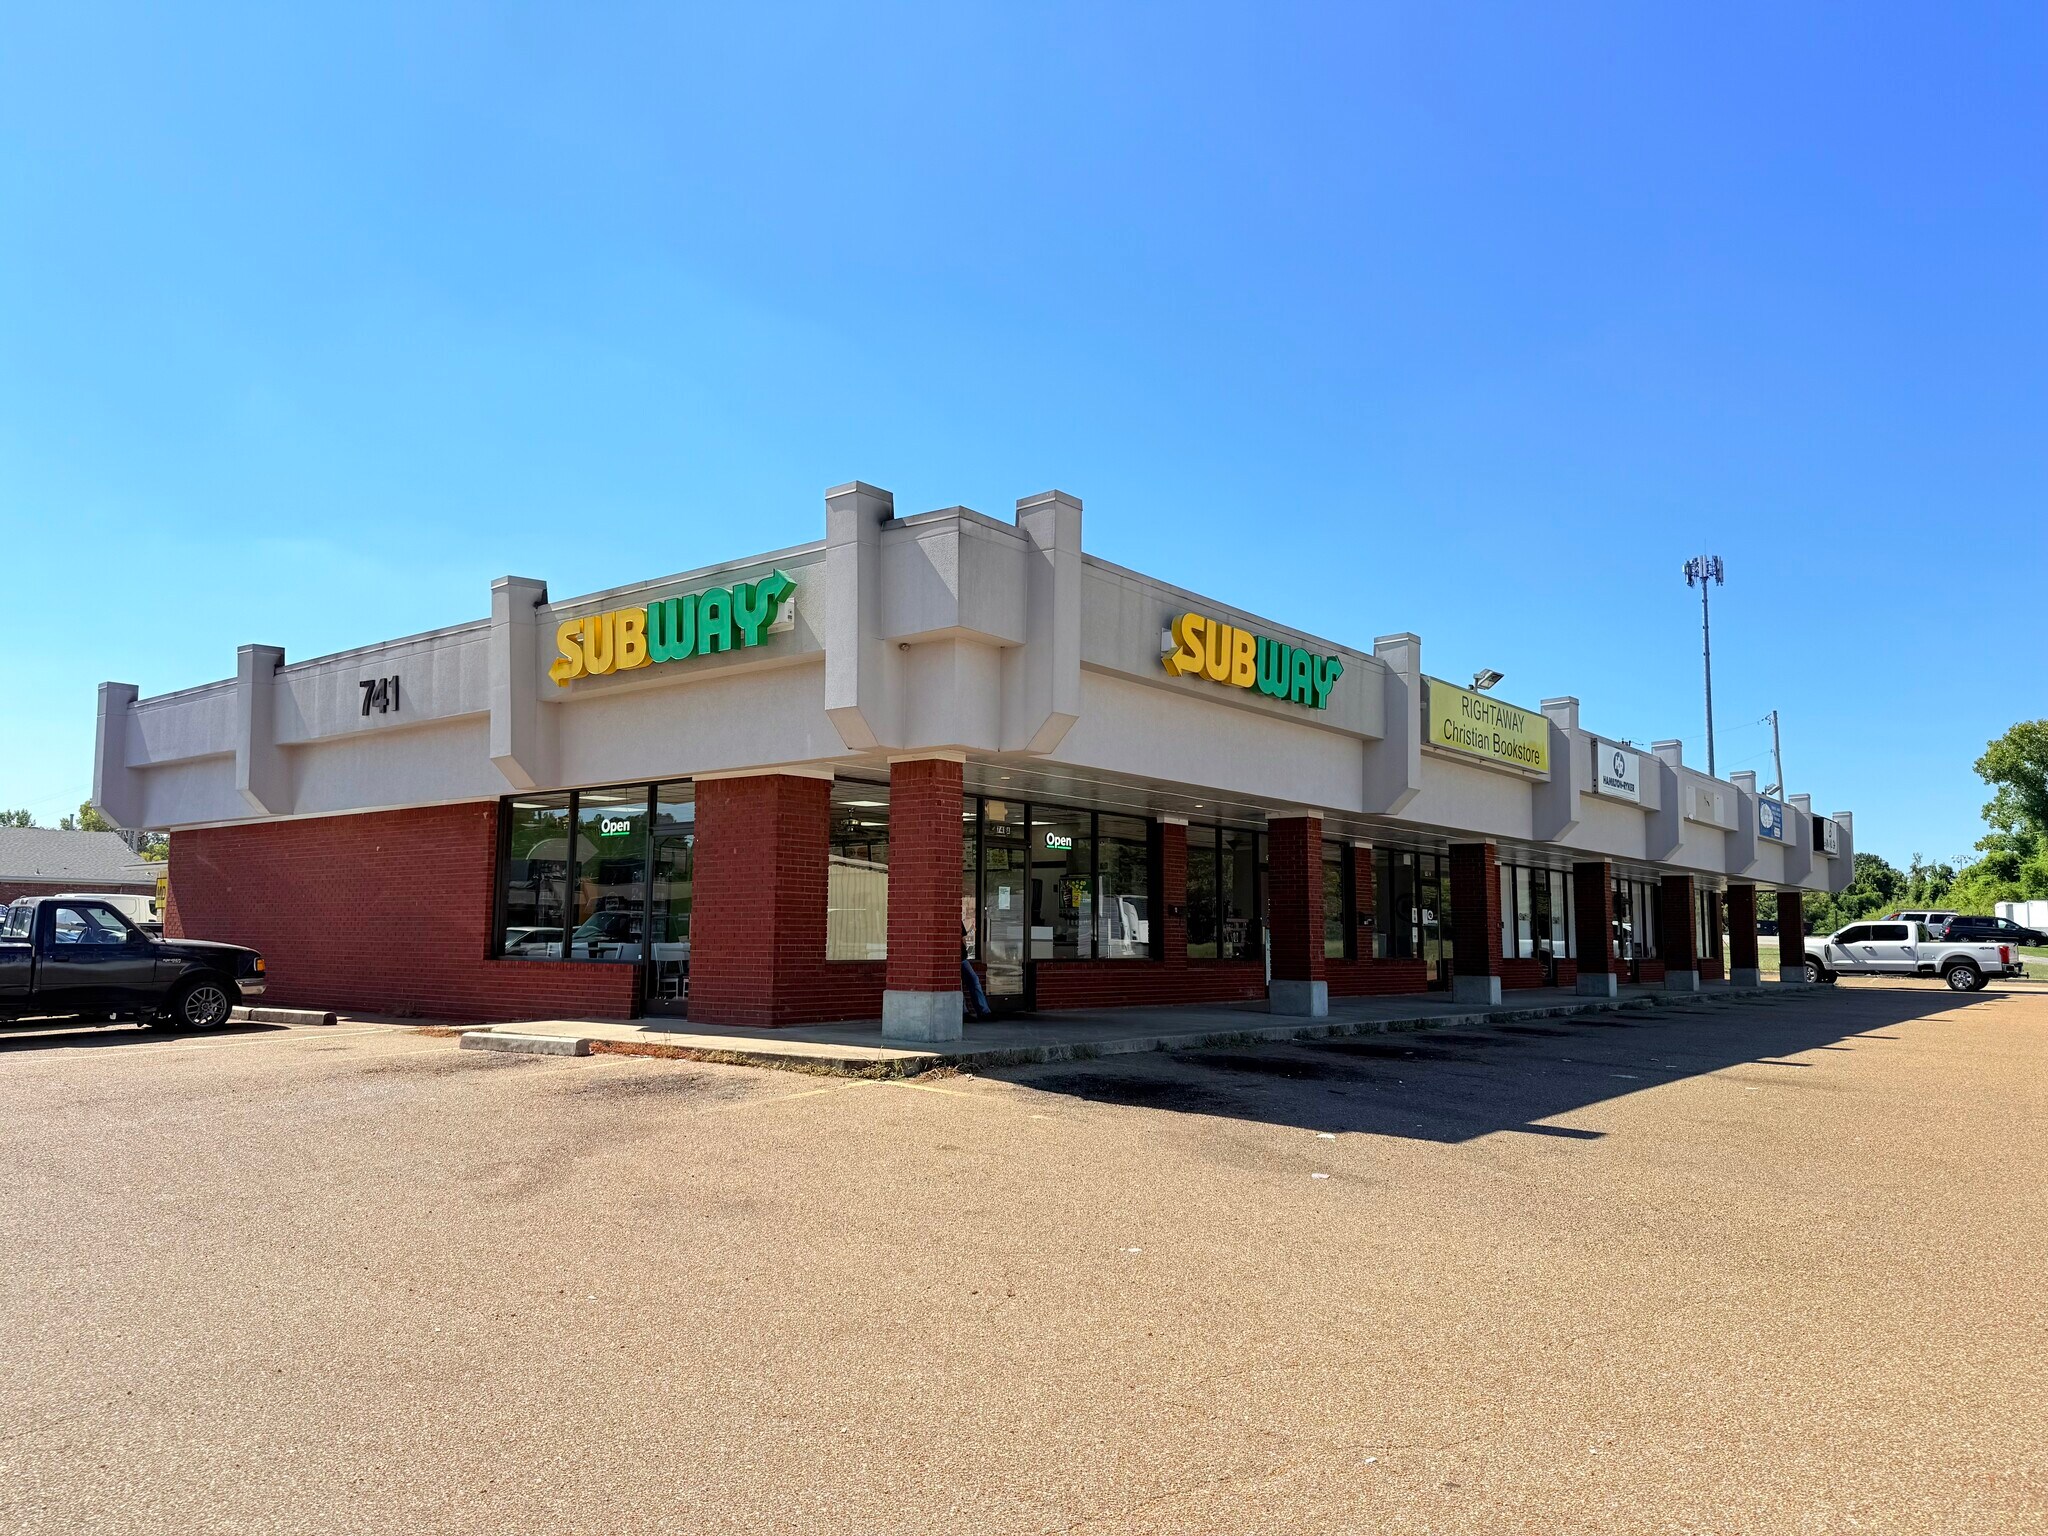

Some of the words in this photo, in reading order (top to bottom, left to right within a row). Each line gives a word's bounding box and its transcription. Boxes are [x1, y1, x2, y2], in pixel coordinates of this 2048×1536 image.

[549, 569, 797, 687] SUBWAY
[1161, 612, 1344, 710] SUBWAY
[359, 675, 400, 716] 741
[1461, 695, 1525, 734] RIGHTAWAY
[1443, 718, 1490, 751] Christian
[1493, 732, 1540, 765] Bookstore
[601, 818, 631, 835] Open
[1046, 832, 1072, 848] Open
